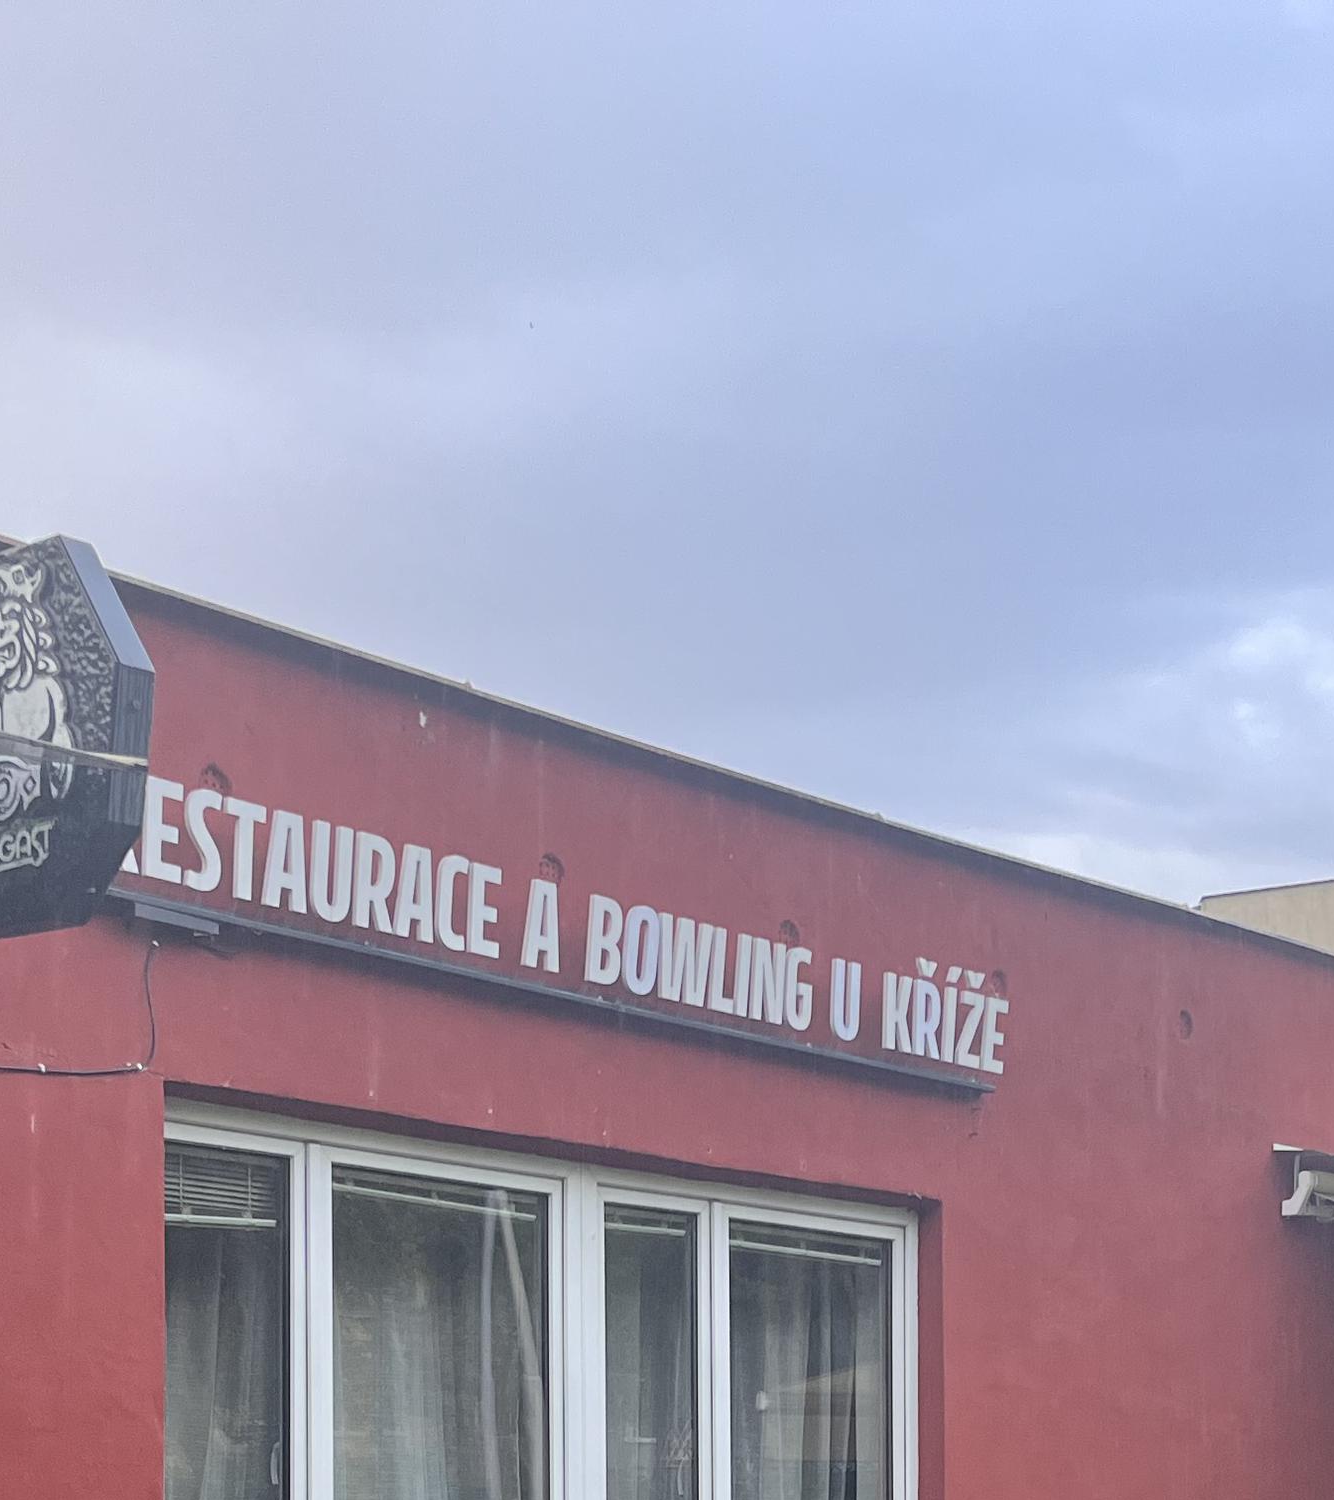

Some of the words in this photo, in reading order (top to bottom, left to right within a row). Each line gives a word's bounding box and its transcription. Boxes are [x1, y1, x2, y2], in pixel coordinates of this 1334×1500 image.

[120, 775, 503, 959] ESTAURACE
[520, 878, 560, 974] A
[584, 893, 814, 1031] BOWLING
[830, 957, 862, 1042] U
[881, 957, 1010, 1075] KŘÍŽE
